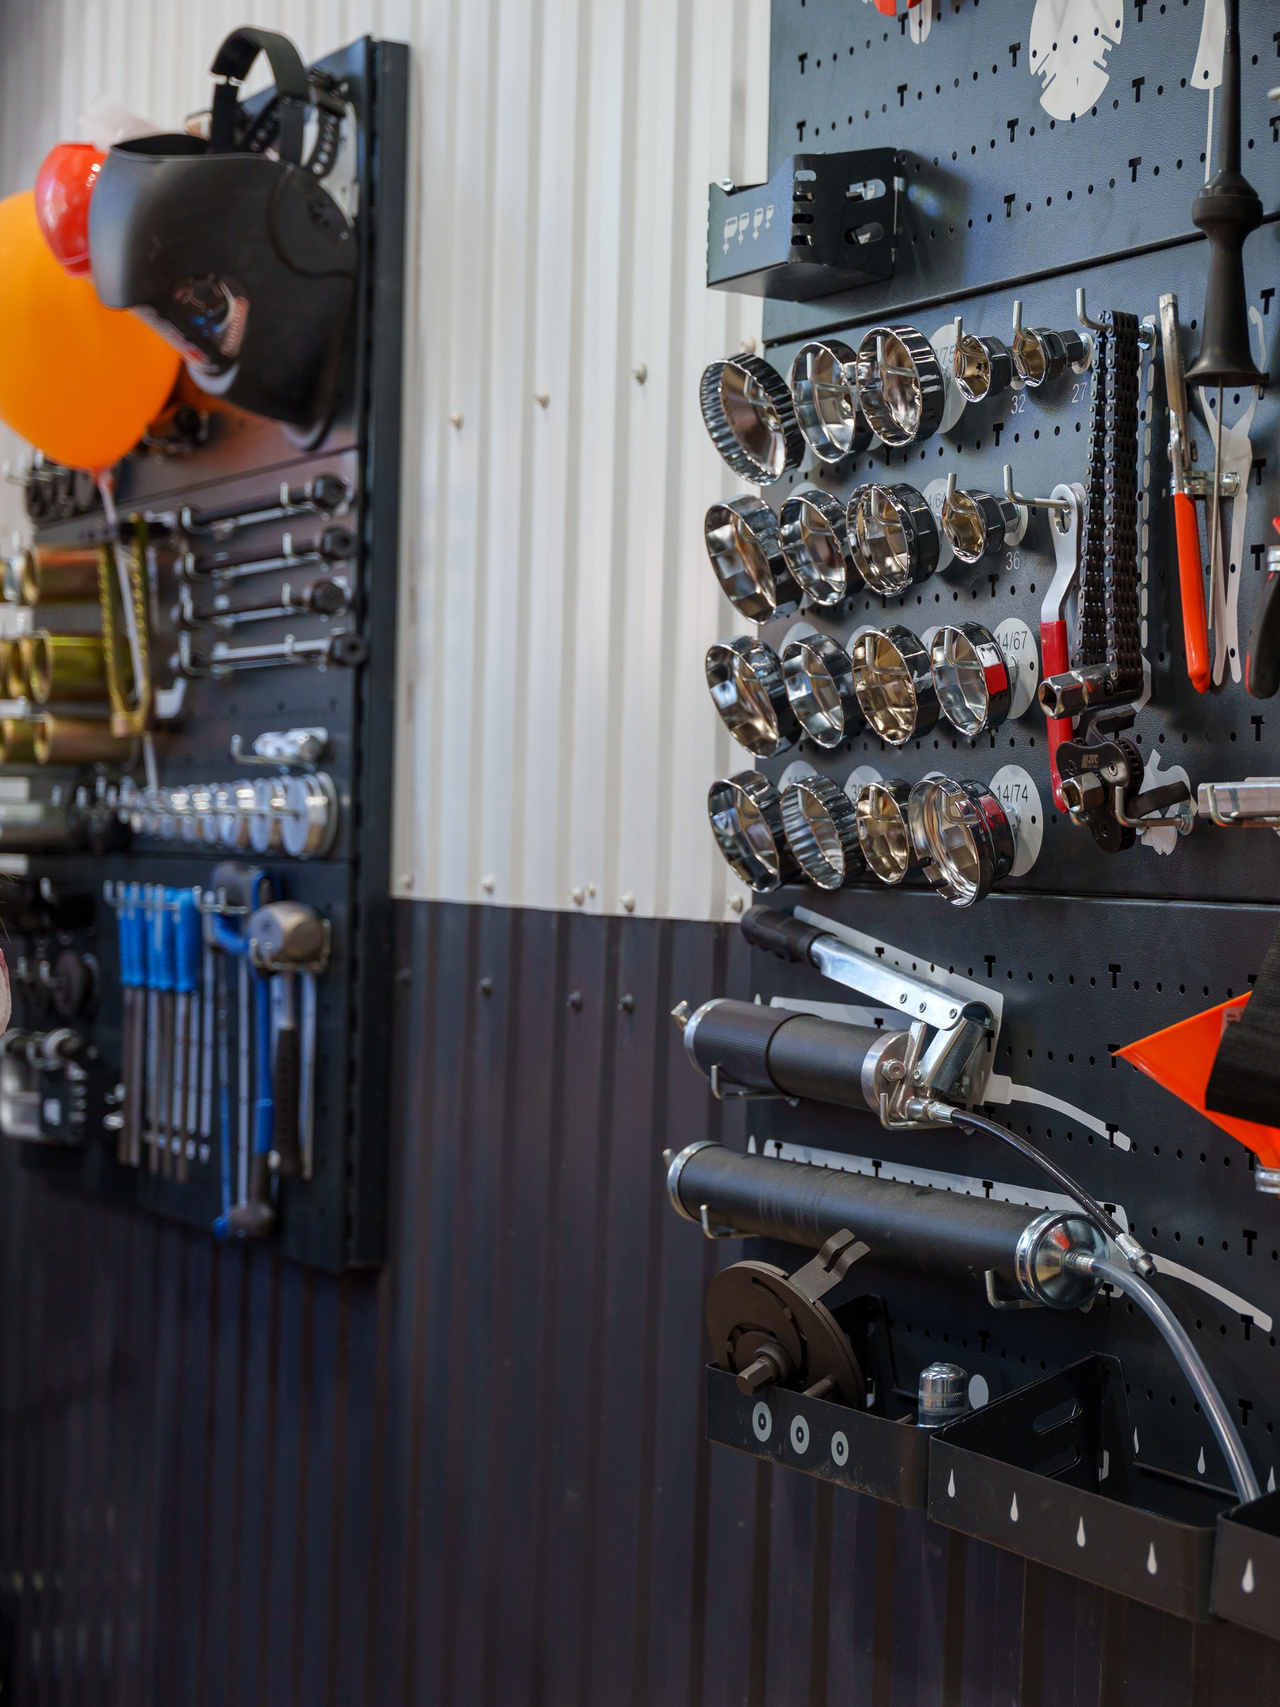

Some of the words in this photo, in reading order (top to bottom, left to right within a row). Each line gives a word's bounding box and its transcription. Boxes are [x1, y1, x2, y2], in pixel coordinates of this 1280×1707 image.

[1071, 382, 1088, 403] 27
[1010, 394, 1026, 414] 32
[1005, 550, 1020, 570] 36
[996, 630, 1028, 651] 14/67
[996, 784, 1029, 803] 14/74
